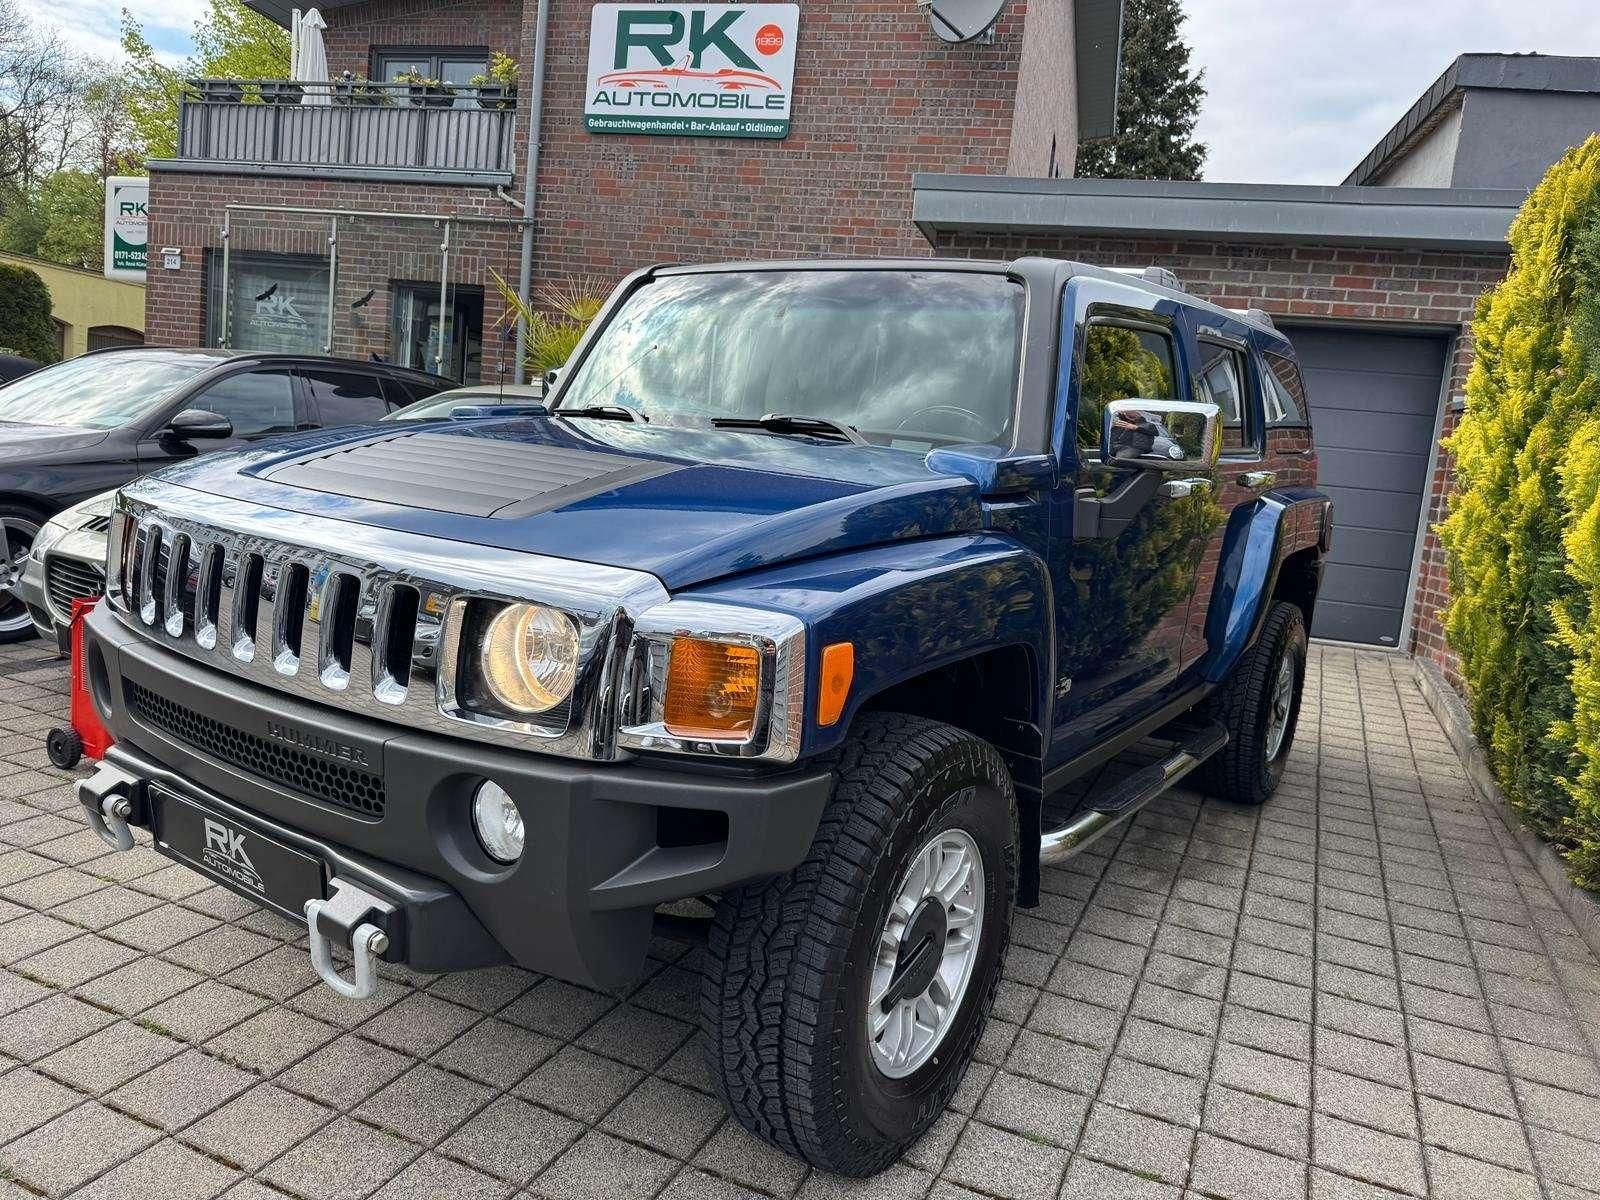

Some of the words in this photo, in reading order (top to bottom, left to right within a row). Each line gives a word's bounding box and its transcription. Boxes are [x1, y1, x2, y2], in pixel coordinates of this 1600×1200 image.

[613, 10, 765, 72] RK
[592, 90, 786, 110] AUTOMOBILE
[588, 118, 685, 131] Gebrauchtwagenhandel
[690, 121, 740, 132] Bar-Ankauf
[745, 123, 784, 133] Oldtimer
[120, 202, 150, 216] RK
[267, 721, 369, 766] HUMMER
[205, 817, 256, 870] RK
[203, 854, 266, 893] AUTOMOBILE
